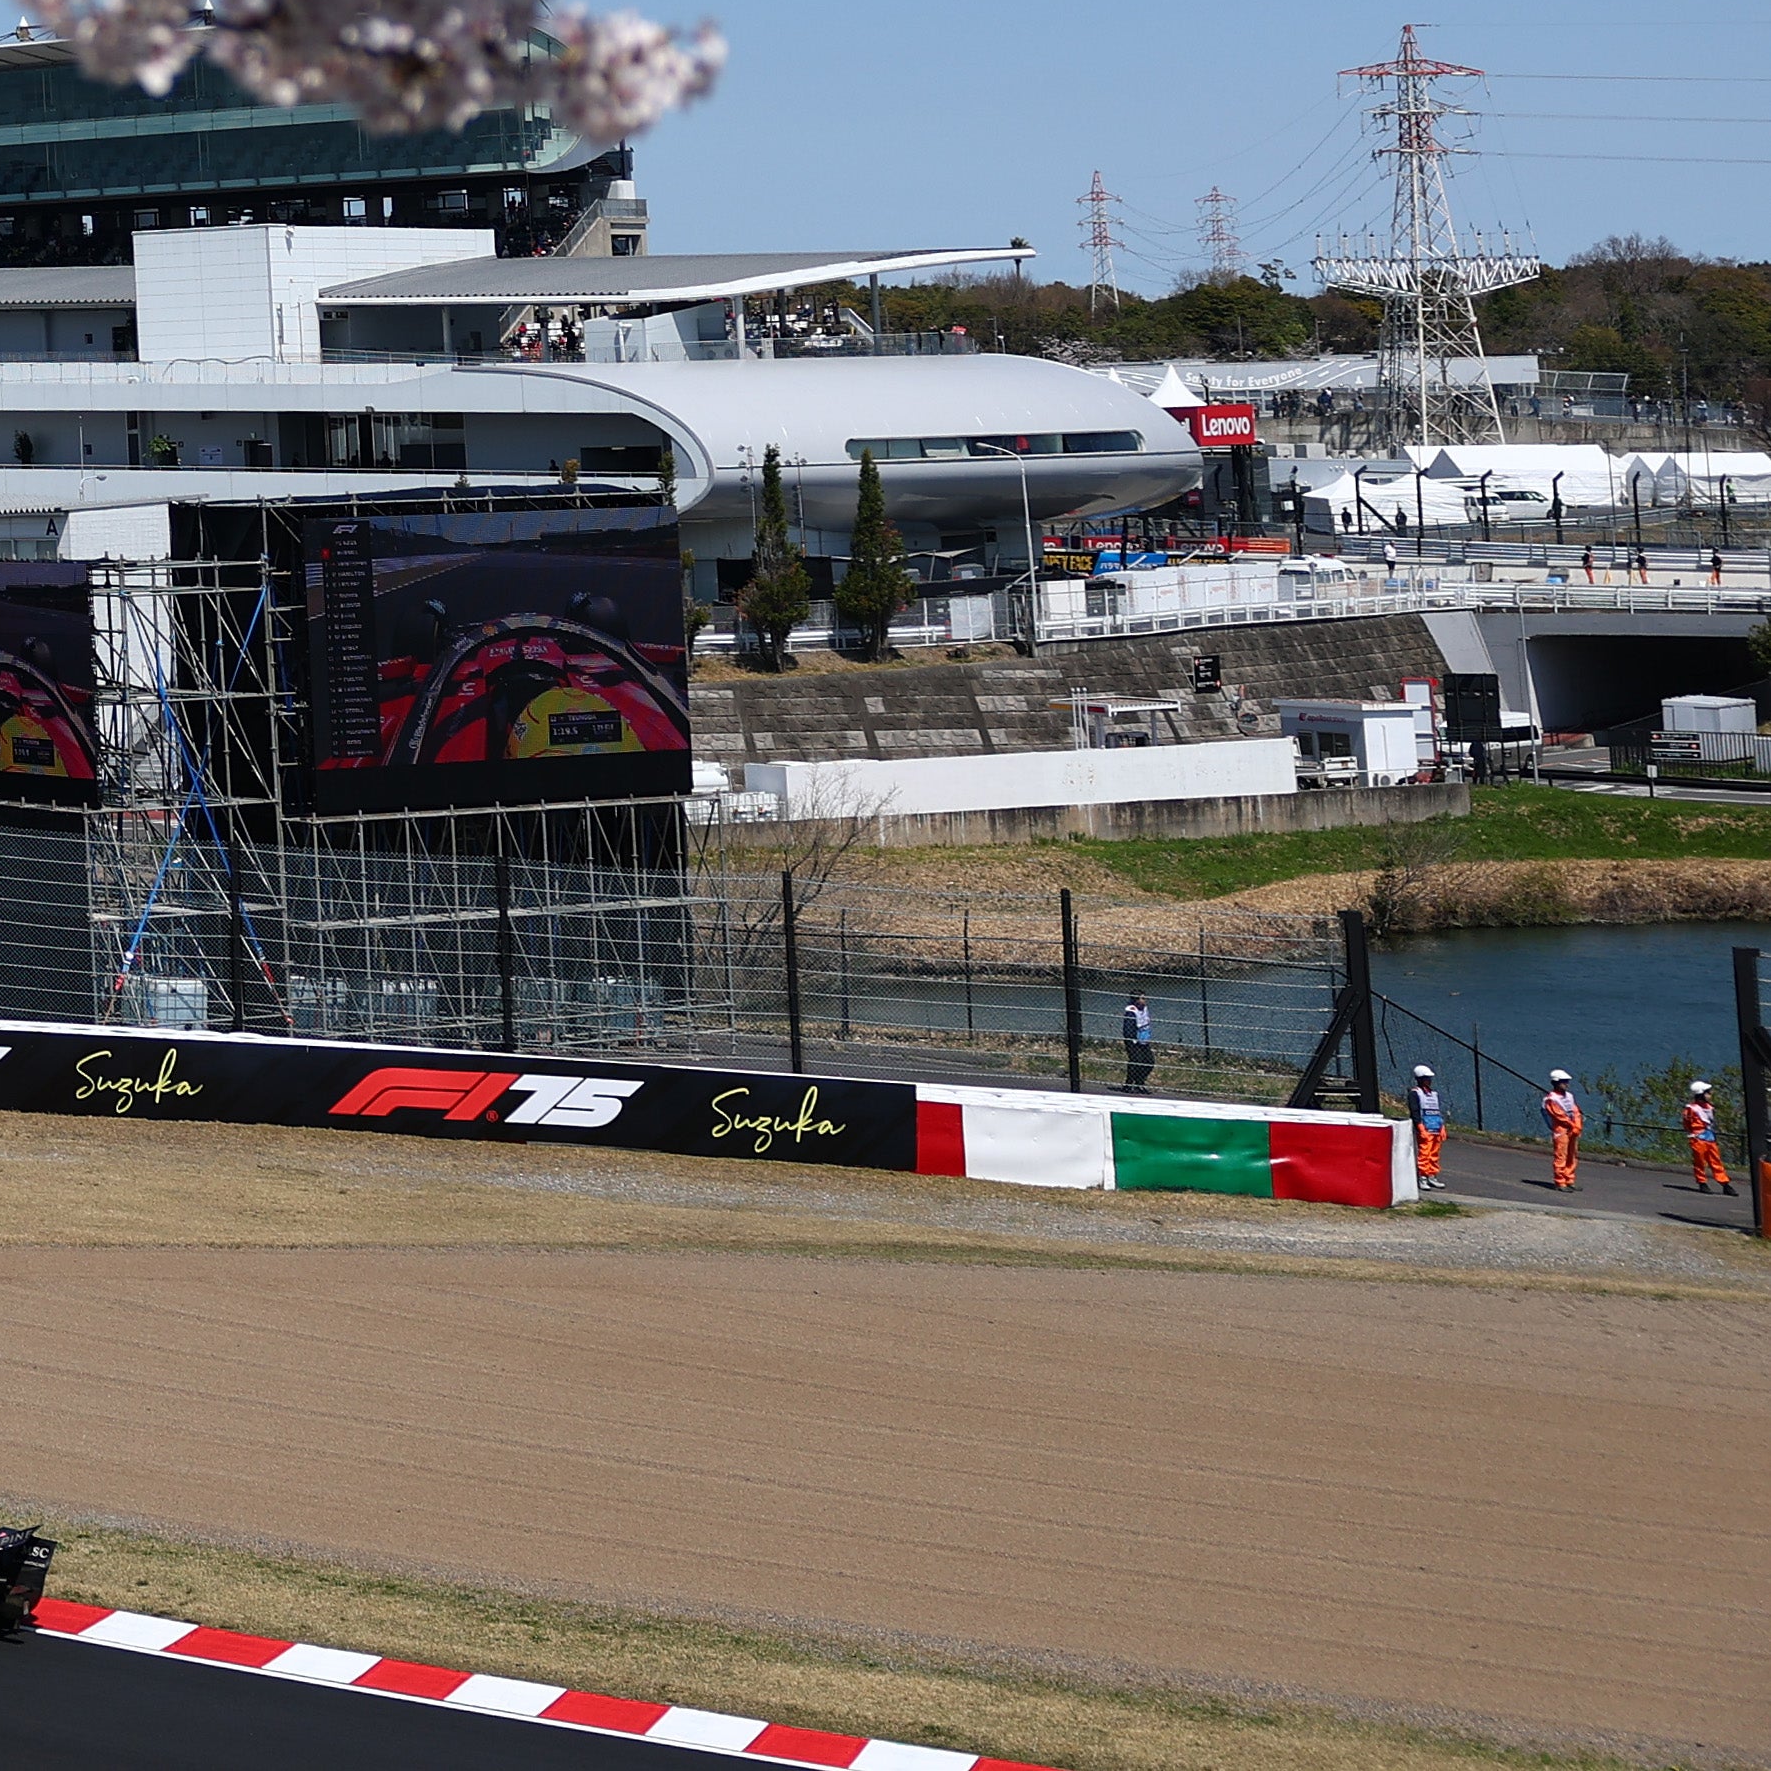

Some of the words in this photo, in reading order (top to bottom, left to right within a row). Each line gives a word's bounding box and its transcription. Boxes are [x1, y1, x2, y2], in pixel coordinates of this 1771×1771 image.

[1226, 377, 1245, 387] for
[1248, 367, 1303, 387] Everyone
[1201, 414, 1251, 437] Lenovo
[46, 518, 58, 536] A
[1070, 555, 1094, 571] FACE
[75, 1048, 203, 1113] Suzuka
[711, 1085, 846, 1152] Suzuka
[31, 1546, 50, 1559] SC
